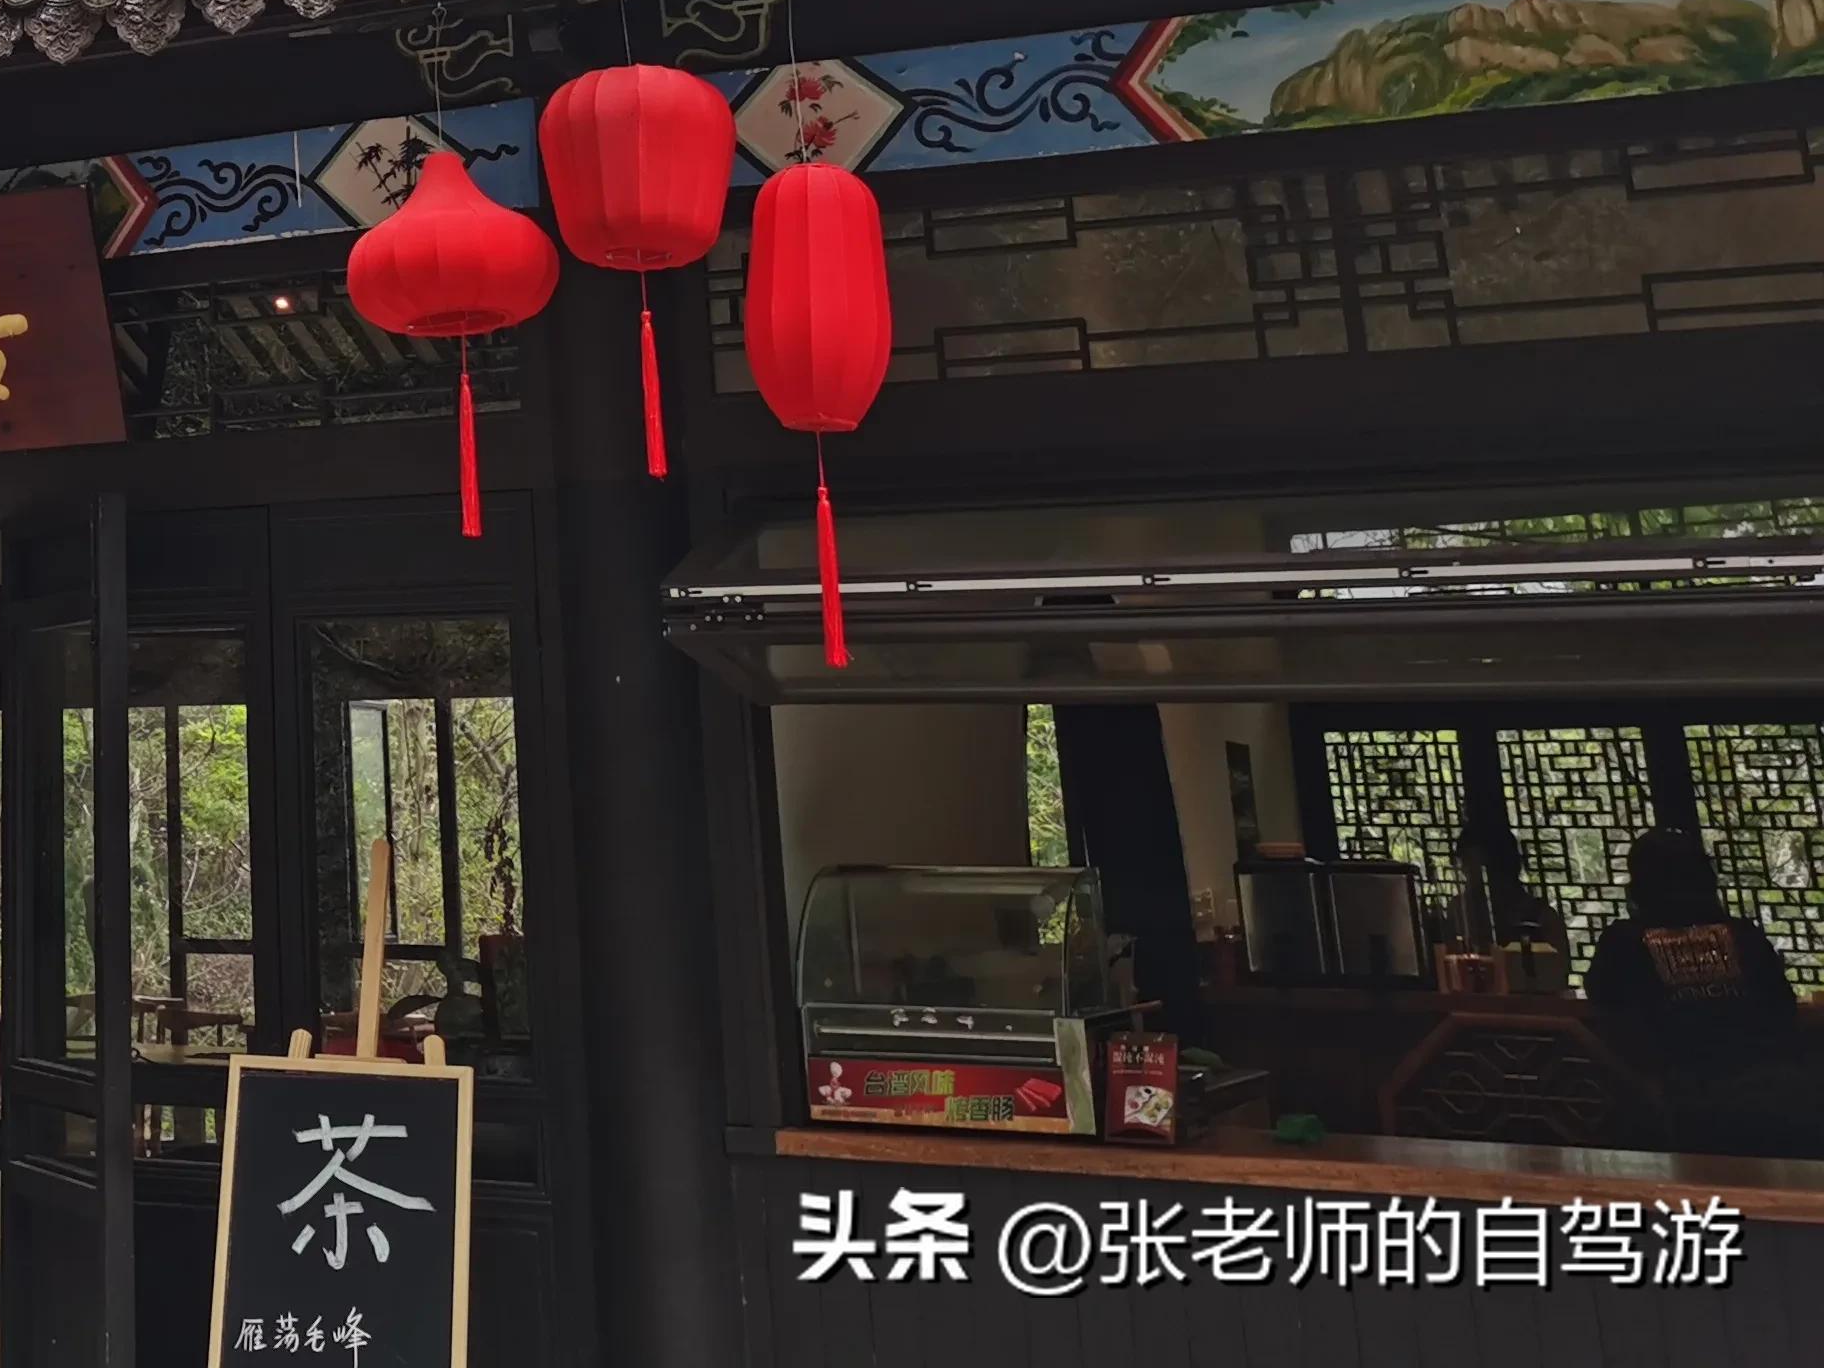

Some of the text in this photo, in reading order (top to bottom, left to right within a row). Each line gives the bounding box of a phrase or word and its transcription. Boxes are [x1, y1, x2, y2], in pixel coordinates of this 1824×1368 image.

[863, 1069, 957, 1097] 台湾风味
[944, 1095, 1016, 1123] 烤香肠
[277, 1113, 437, 1270] 茶
[233, 1305, 372, 1368] 雁荡毛峰
